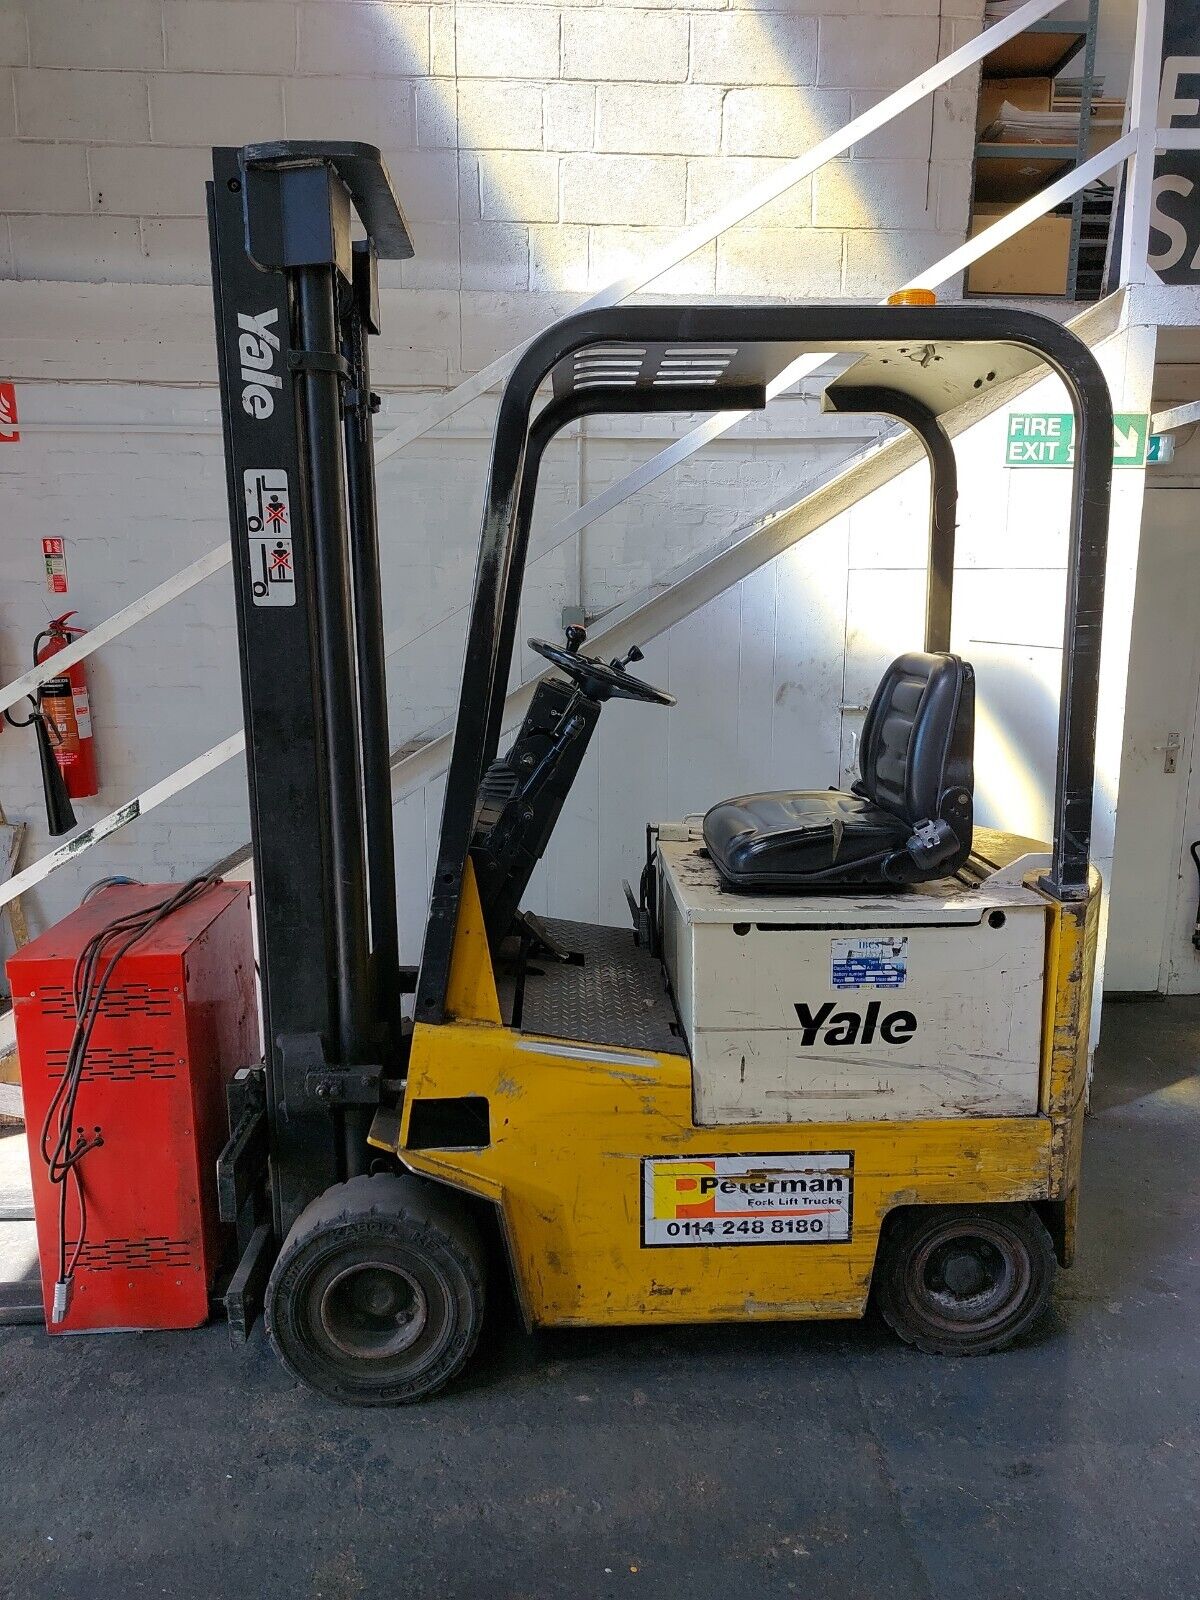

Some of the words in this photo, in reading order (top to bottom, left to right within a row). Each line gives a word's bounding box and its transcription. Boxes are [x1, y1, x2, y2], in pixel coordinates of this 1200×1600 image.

[237, 307, 283, 420] Yale
[1010, 417, 1061, 437] FIRE
[1009, 441, 1059, 461] EXIT
[793, 1001, 917, 1046] Yale
[701, 1176, 843, 1194] Peterman
[747, 1198, 774, 1206] Fork
[779, 1197, 798, 1206] Lift
[802, 1197, 842, 1206] Trucks
[667, 1221, 715, 1236] 0114
[722, 1220, 765, 1235] 248
[771, 1218, 823, 1234] 8180
